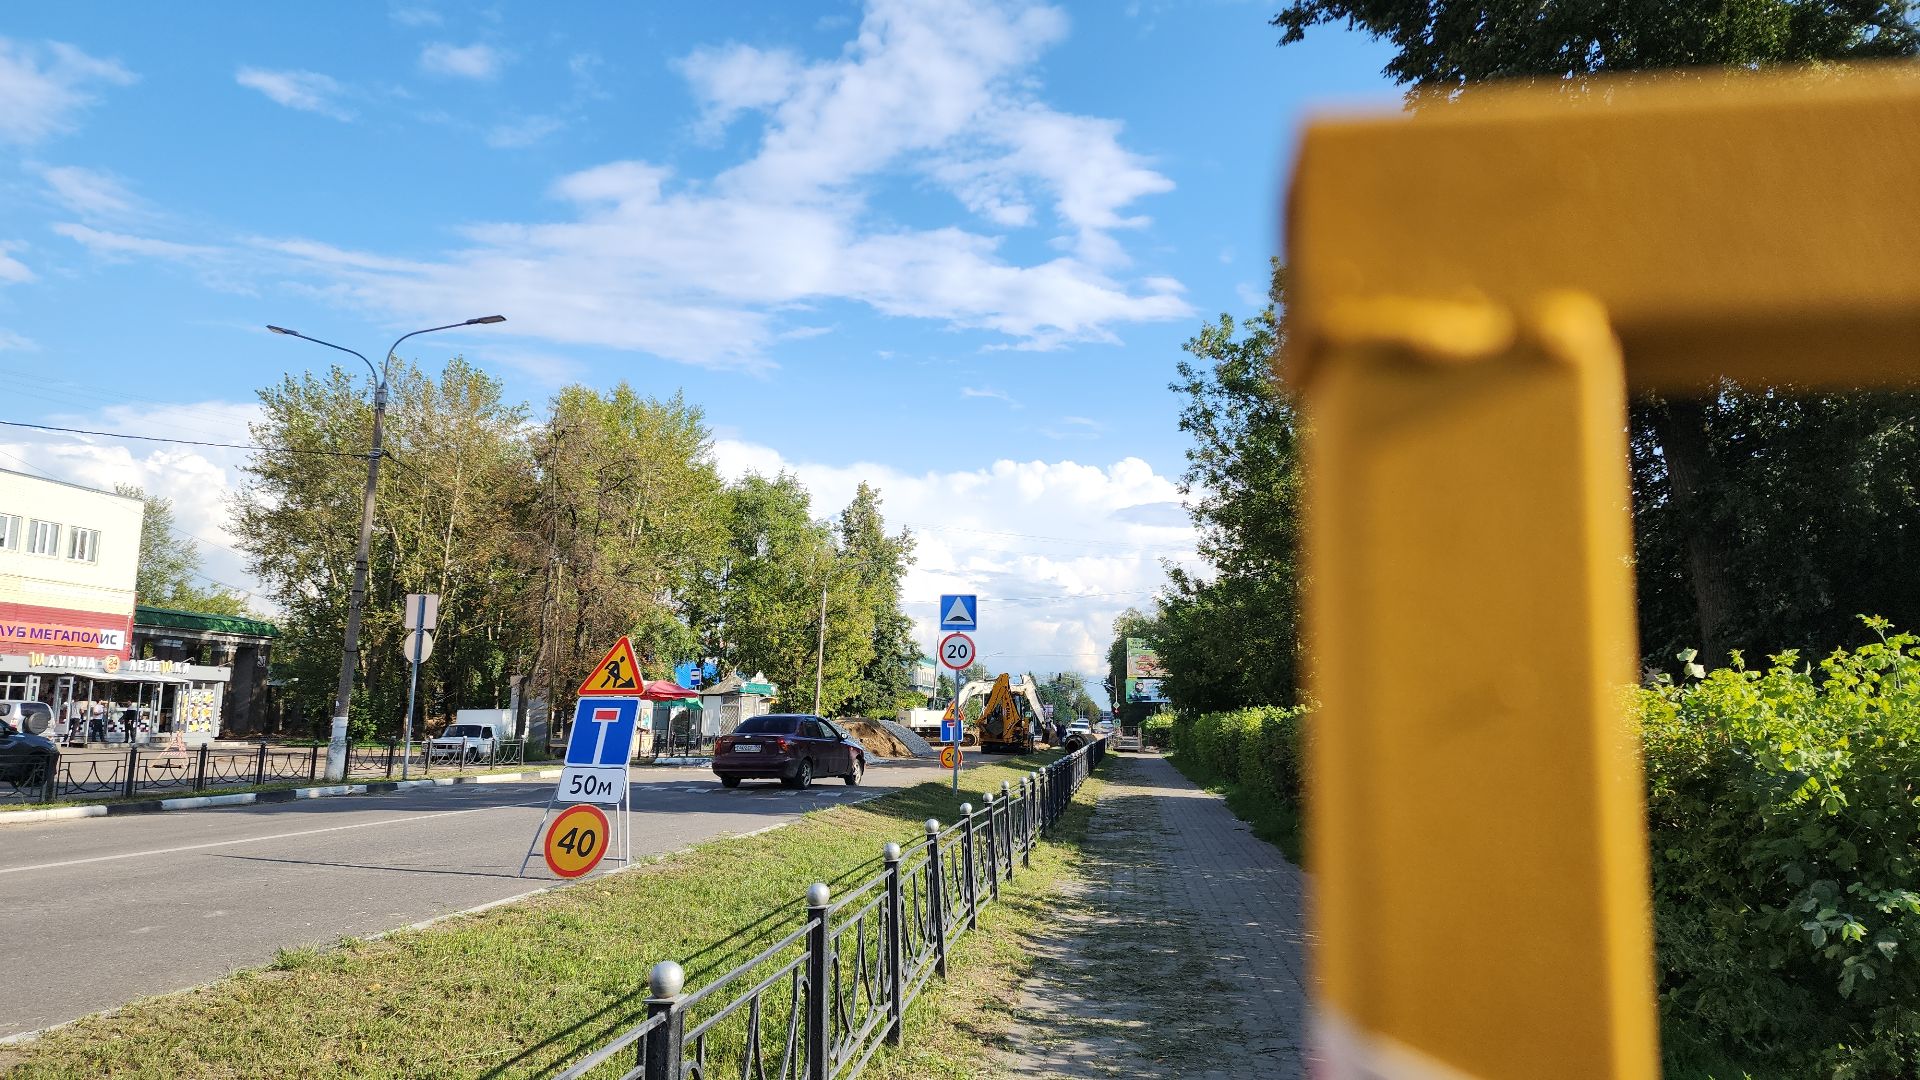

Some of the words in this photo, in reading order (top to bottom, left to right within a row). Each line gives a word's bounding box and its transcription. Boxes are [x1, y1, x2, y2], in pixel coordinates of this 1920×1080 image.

[29, 627, 118, 645] МЕГАПОЛИС
[947, 644, 968, 659] 20
[108, 657, 118, 666] 24
[129, 659, 190, 674] ЛЕПЕШКИ
[557, 827, 596, 858] 40
